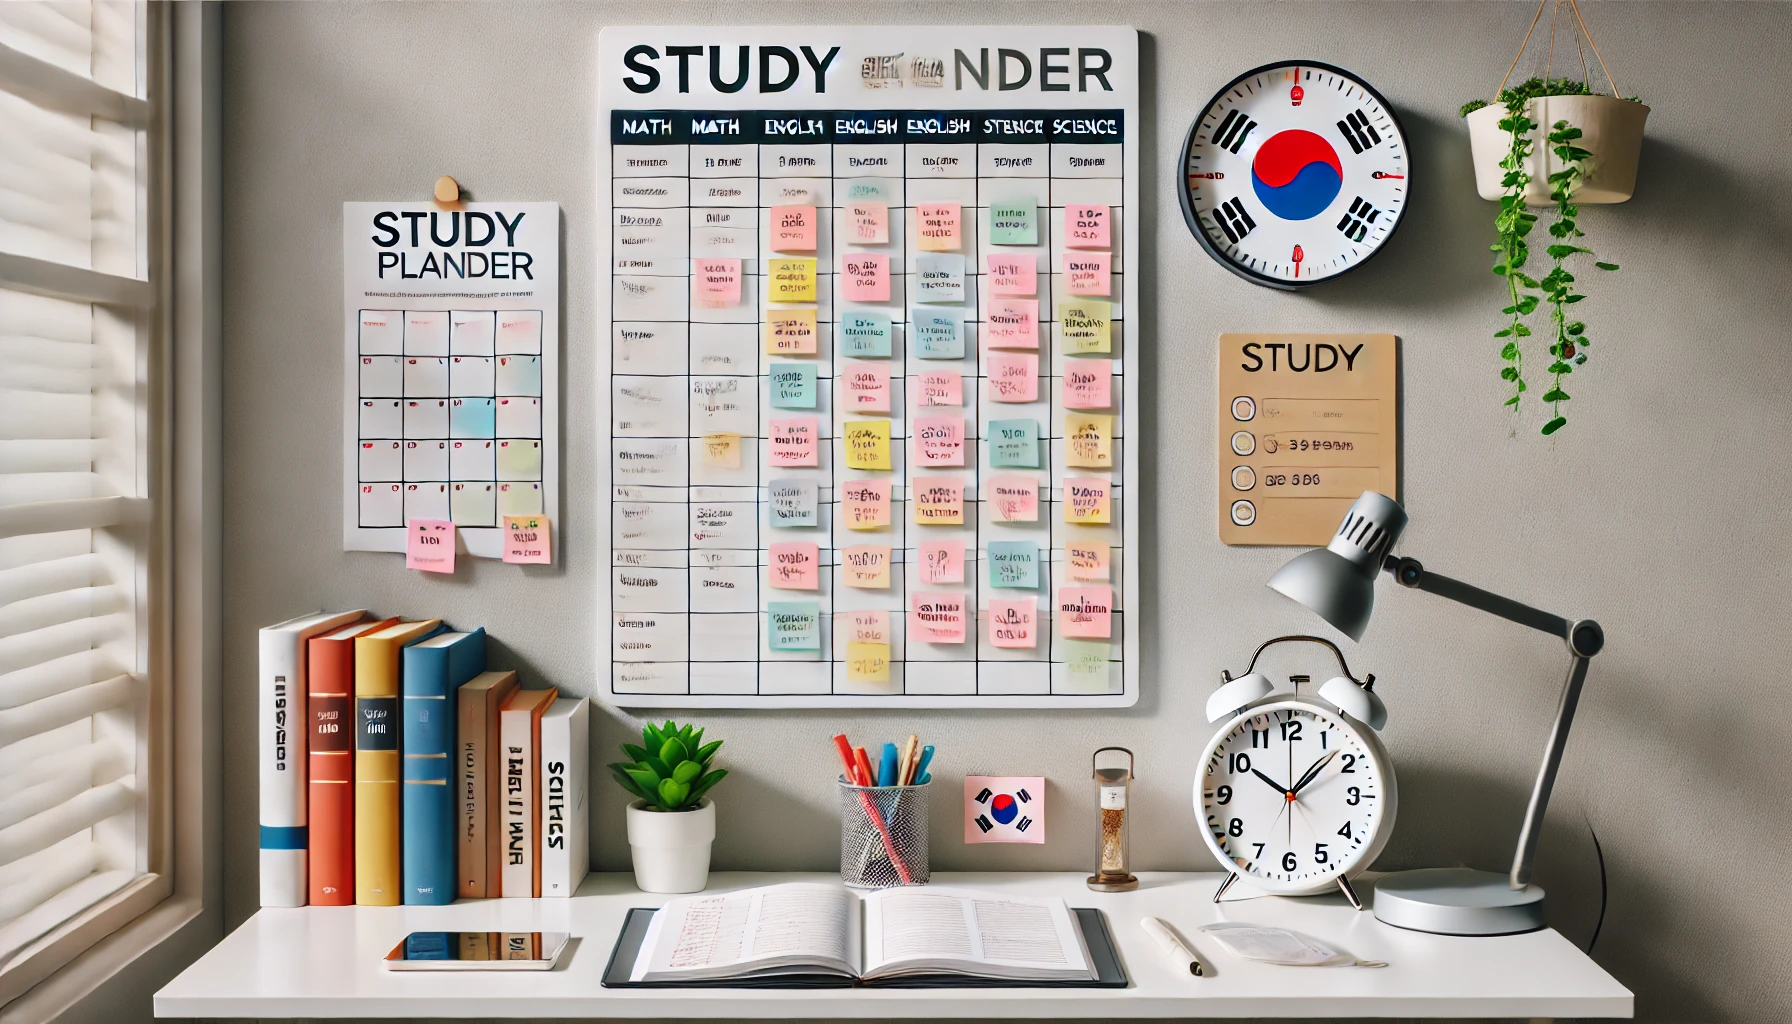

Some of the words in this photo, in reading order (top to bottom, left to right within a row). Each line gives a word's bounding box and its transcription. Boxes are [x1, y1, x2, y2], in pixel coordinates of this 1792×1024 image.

[623, 45, 840, 93] STUDY
[623, 119, 671, 134] MATH
[692, 119, 739, 134] MATH
[372, 212, 525, 247] STUDY
[379, 252, 533, 280] PLANDER
[1242, 343, 1363, 372] STUDY
[1280, 721, 1302, 741] 12
[1229, 753, 1250, 774] 10
[1341, 754, 1355, 773] 2
[1217, 785, 1232, 805] 9
[1229, 818, 1243, 837] 8
[1337, 821, 1351, 839] 4
[1253, 843, 1265, 859] 7
[1315, 843, 1328, 863] 5
[1282, 852, 1296, 872] 6
